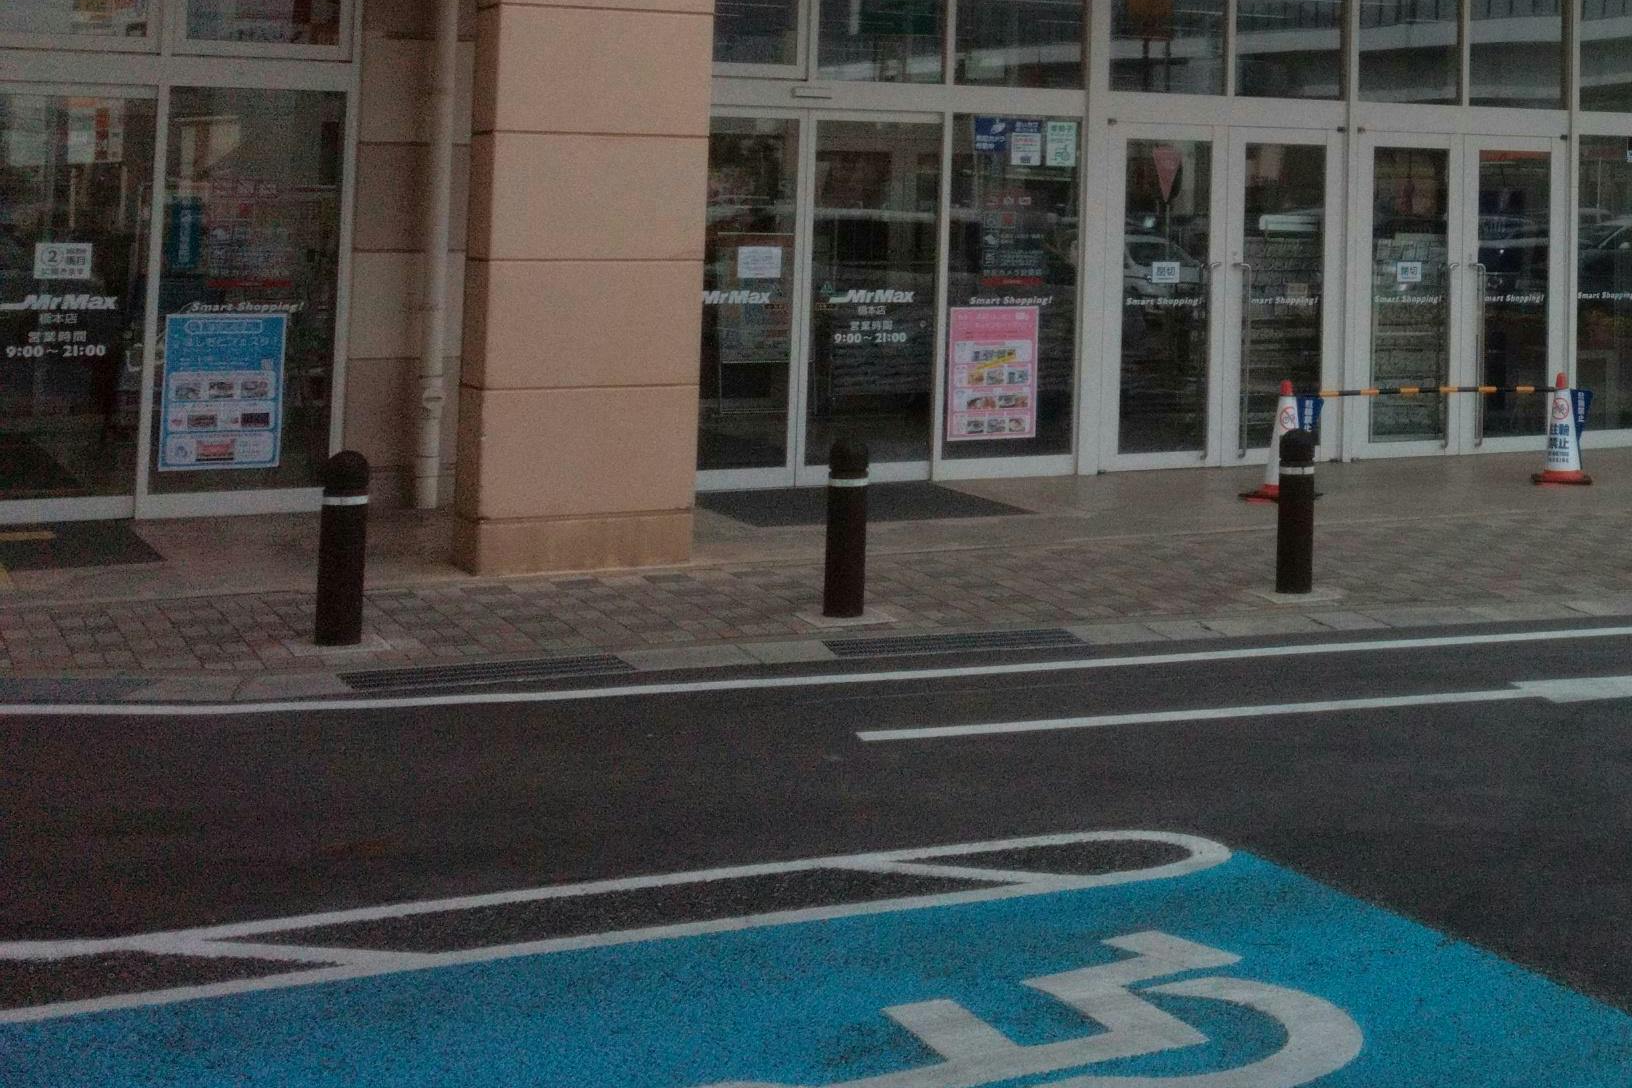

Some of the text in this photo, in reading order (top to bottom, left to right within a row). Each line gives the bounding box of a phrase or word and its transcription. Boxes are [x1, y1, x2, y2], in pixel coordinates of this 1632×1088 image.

[828, 289, 917, 304] MrMax
[1374, 294, 1400, 304] Smart
[1577, 291, 1599, 300] Smart
[969, 296, 1053, 306] Smart Shopping!
[1126, 297, 1154, 306] Smart
[1274, 296, 1319, 307] Shopping!
[191, 301, 304, 312] Smart Shopping!
[28, 331, 87, 343] 営業時間
